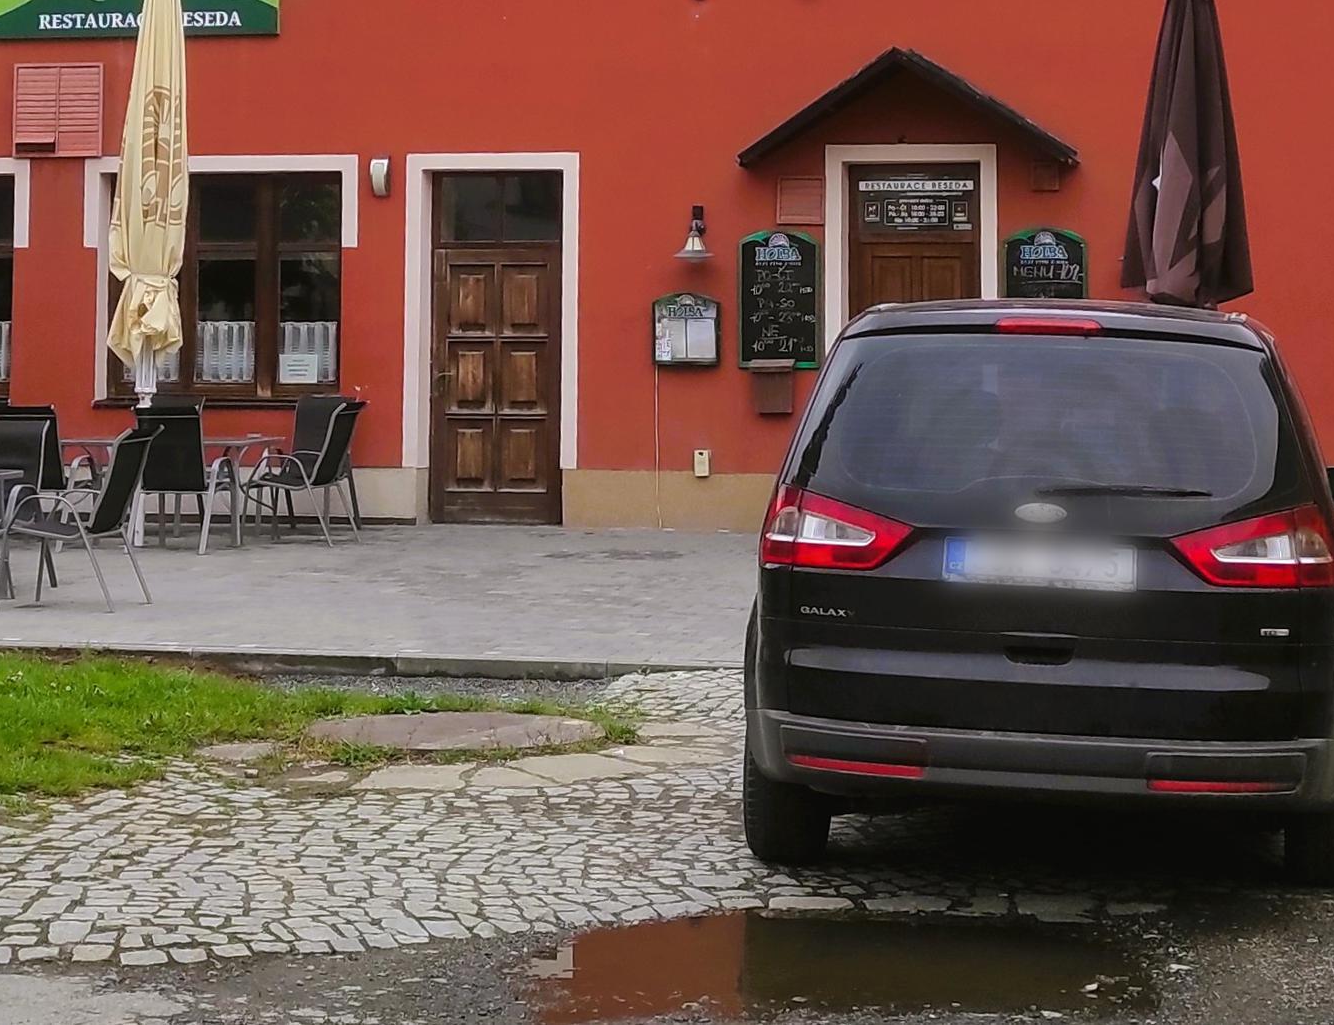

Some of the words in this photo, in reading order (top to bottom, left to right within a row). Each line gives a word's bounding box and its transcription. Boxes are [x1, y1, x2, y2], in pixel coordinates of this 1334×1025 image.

[38, 12, 144, 29] RESTAURAC
[181, 10, 243, 27] ESEDA
[864, 182, 926, 190] RESTAURACE
[931, 181, 969, 190] BESEDA
[754, 246, 802, 262] HOLBA
[1020, 245, 1068, 259] HOLBA
[1012, 265, 1054, 279] MENU
